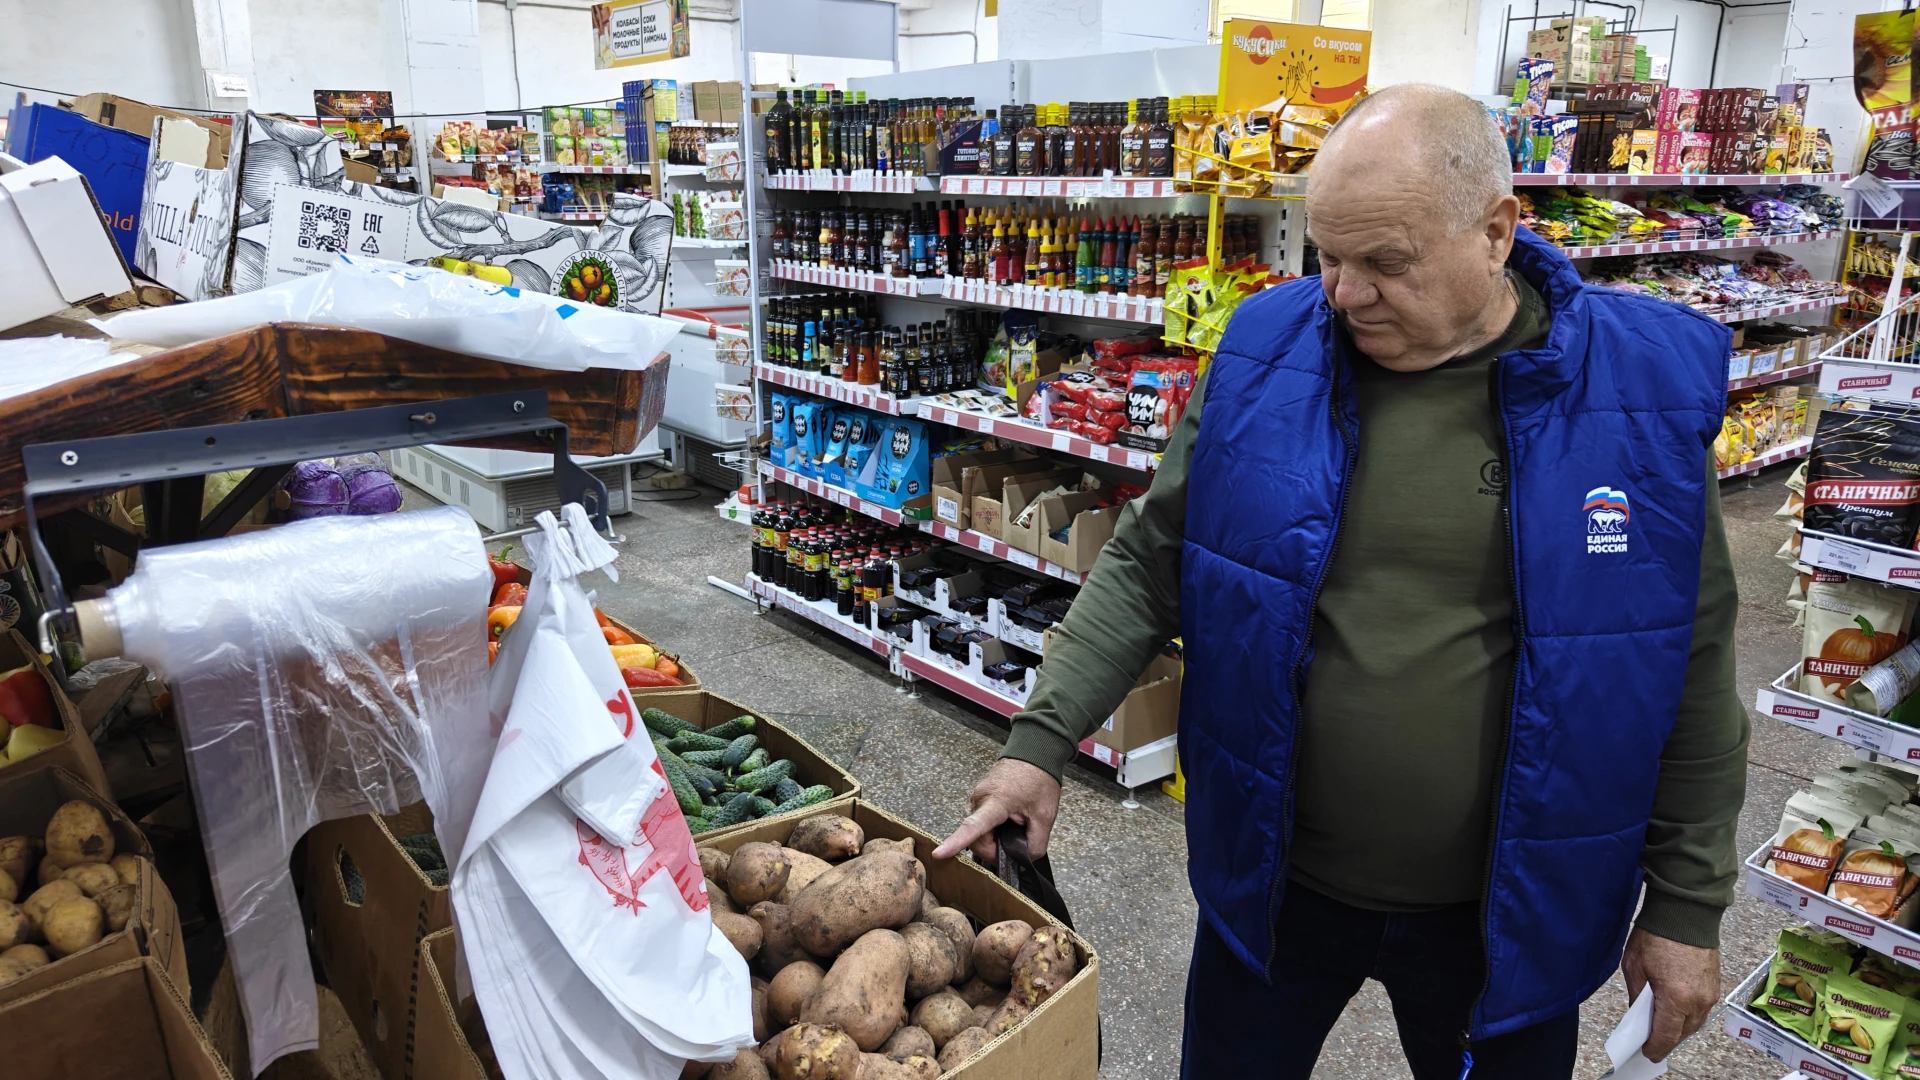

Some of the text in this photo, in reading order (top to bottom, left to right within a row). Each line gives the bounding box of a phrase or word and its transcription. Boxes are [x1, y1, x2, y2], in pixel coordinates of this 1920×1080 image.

[616, 17, 640, 28] КОЛБАСЫ
[643, 14, 656, 24] СОКИ
[612, 28, 640, 39] МОЛОЧНЫЕ
[643, 25, 657, 34] ВОДА
[643, 33, 667, 44] ЛИМОНАД
[614, 39, 640, 50] ПРОДУКТЫ
[1313, 36, 1363, 53] Со вкусом
[1334, 54, 1360, 65] на ты
[151, 202, 186, 247] VILLA
[1841, 377, 1889, 387] СТАНИЧНЫЕ
[1128, 392, 1158, 408] ЧИМ
[1128, 405, 1155, 422] ЧИМ
[1813, 485, 1919, 500] СТАНИЧНЫЕ
[1836, 502, 1894, 518] Премиум
[1587, 534, 1628, 544] ЕДИНАЯ
[1587, 544, 1628, 553] РОССИЯ
[1775, 706, 1816, 718] СТАНИЧНЫЕ
[1828, 917, 1872, 934] СТАНИЧНЫЕ
[1768, 997, 1811, 1015] СТАНИЧНЫЕ
[1823, 1043, 1868, 1062] СТАНИЧНЫЕ
